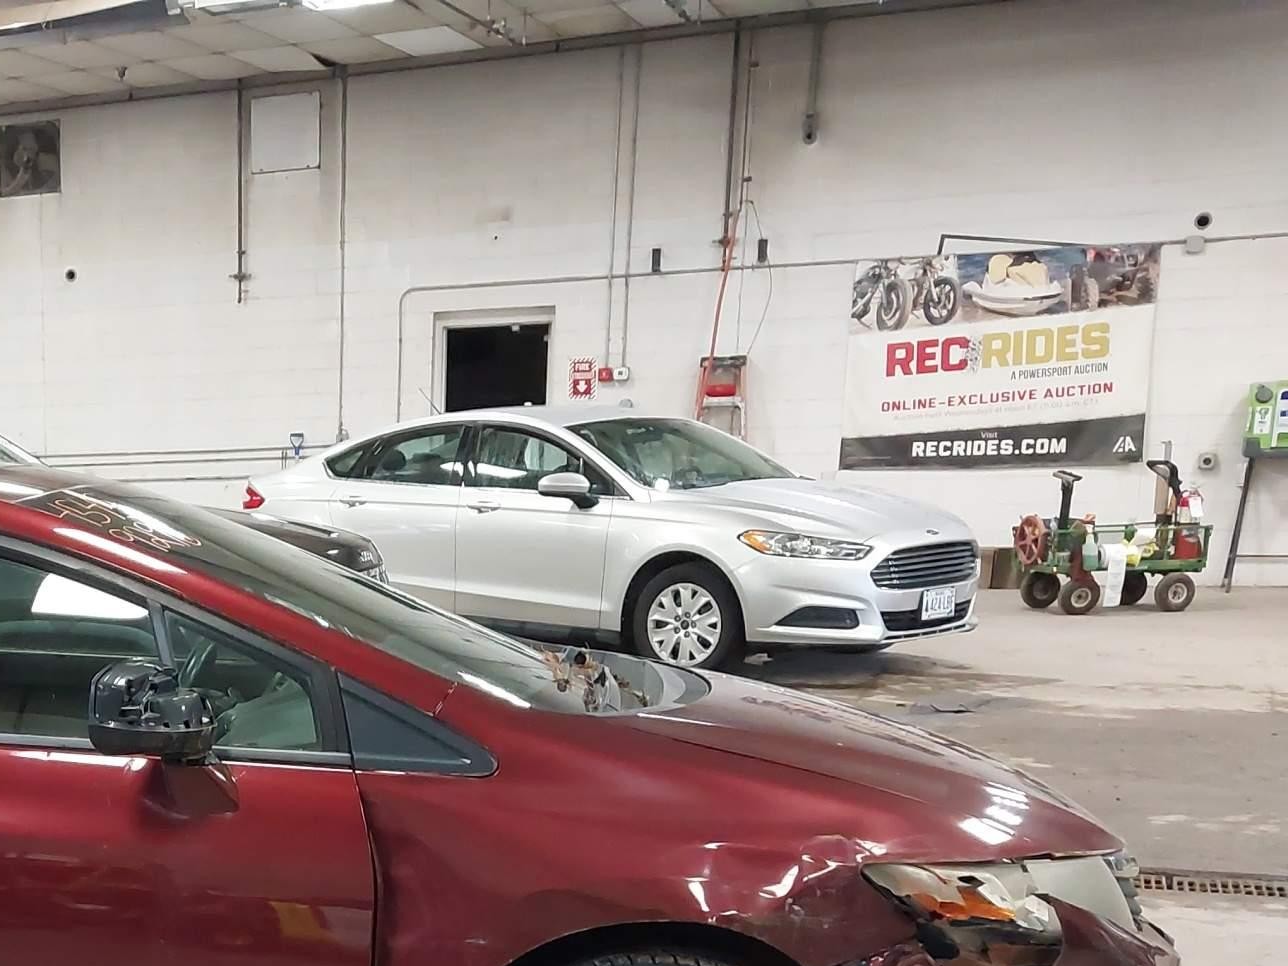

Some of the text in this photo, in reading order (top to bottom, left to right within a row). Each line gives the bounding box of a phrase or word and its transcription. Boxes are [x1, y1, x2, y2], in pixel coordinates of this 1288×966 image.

[885, 321, 1111, 378] REC RIDES
[1010, 361, 1109, 380] A POWERSPORT AUCTION
[880, 389, 1038, 413] ONLINE-EXCLUSIVE
[1043, 381, 1114, 400] AUCTION
[980, 431, 999, 439] Visit
[911, 437, 1067, 457] RECRIDES.COM
